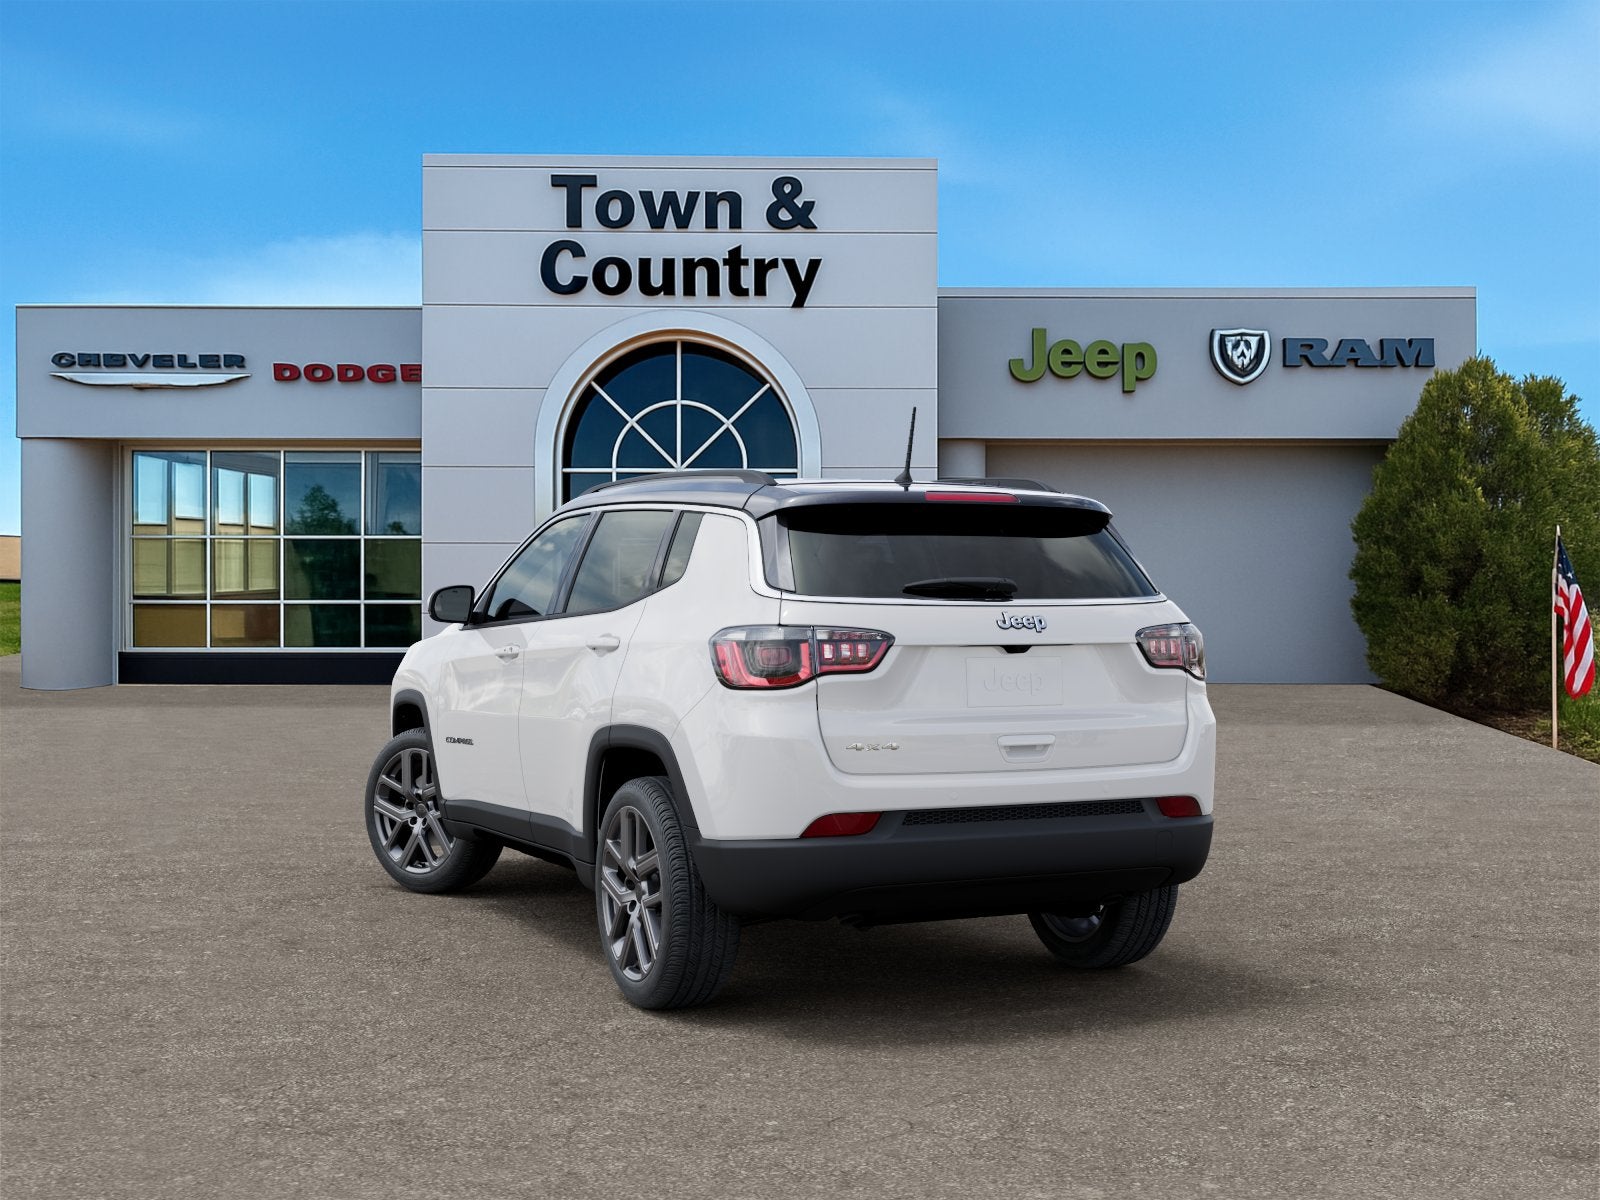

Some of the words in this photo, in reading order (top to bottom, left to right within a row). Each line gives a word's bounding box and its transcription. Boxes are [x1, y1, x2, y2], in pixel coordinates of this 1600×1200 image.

[551, 174, 742, 229] Town
[766, 176, 818, 230] &
[540, 239, 822, 308] Country
[1009, 328, 1158, 393] Jeep
[1282, 338, 1435, 368] RAM
[273, 363, 422, 382] DODGE
[996, 613, 1048, 633] Jeep
[984, 663, 1045, 696] Jeep
